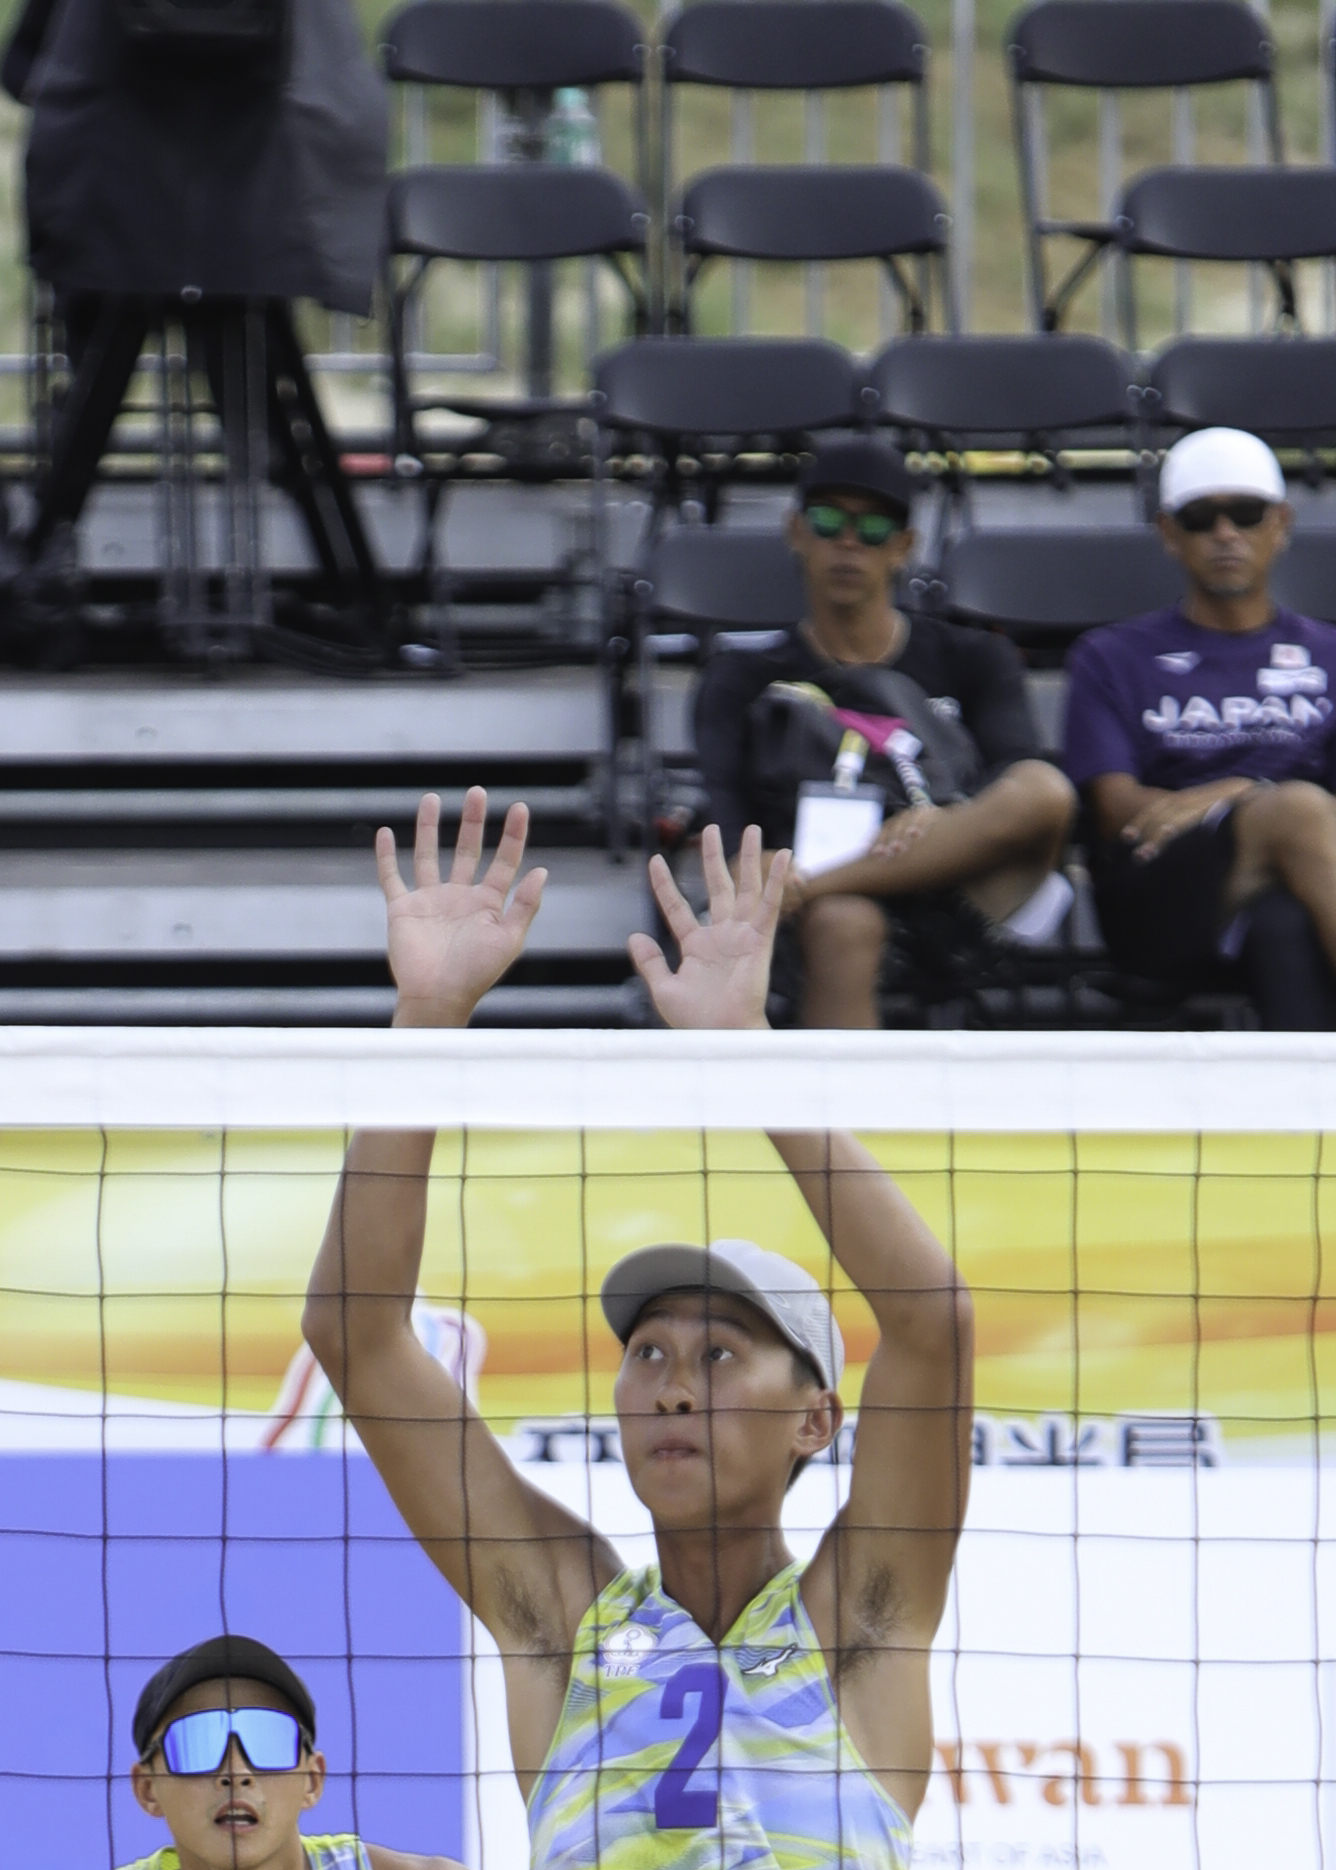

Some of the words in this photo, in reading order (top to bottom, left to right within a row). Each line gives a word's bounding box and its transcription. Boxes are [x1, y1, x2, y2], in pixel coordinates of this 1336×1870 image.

[1142, 695, 1333, 733] JAPAN
[655, 1663, 730, 1829] 2
[927, 1737, 1194, 1806] wan
